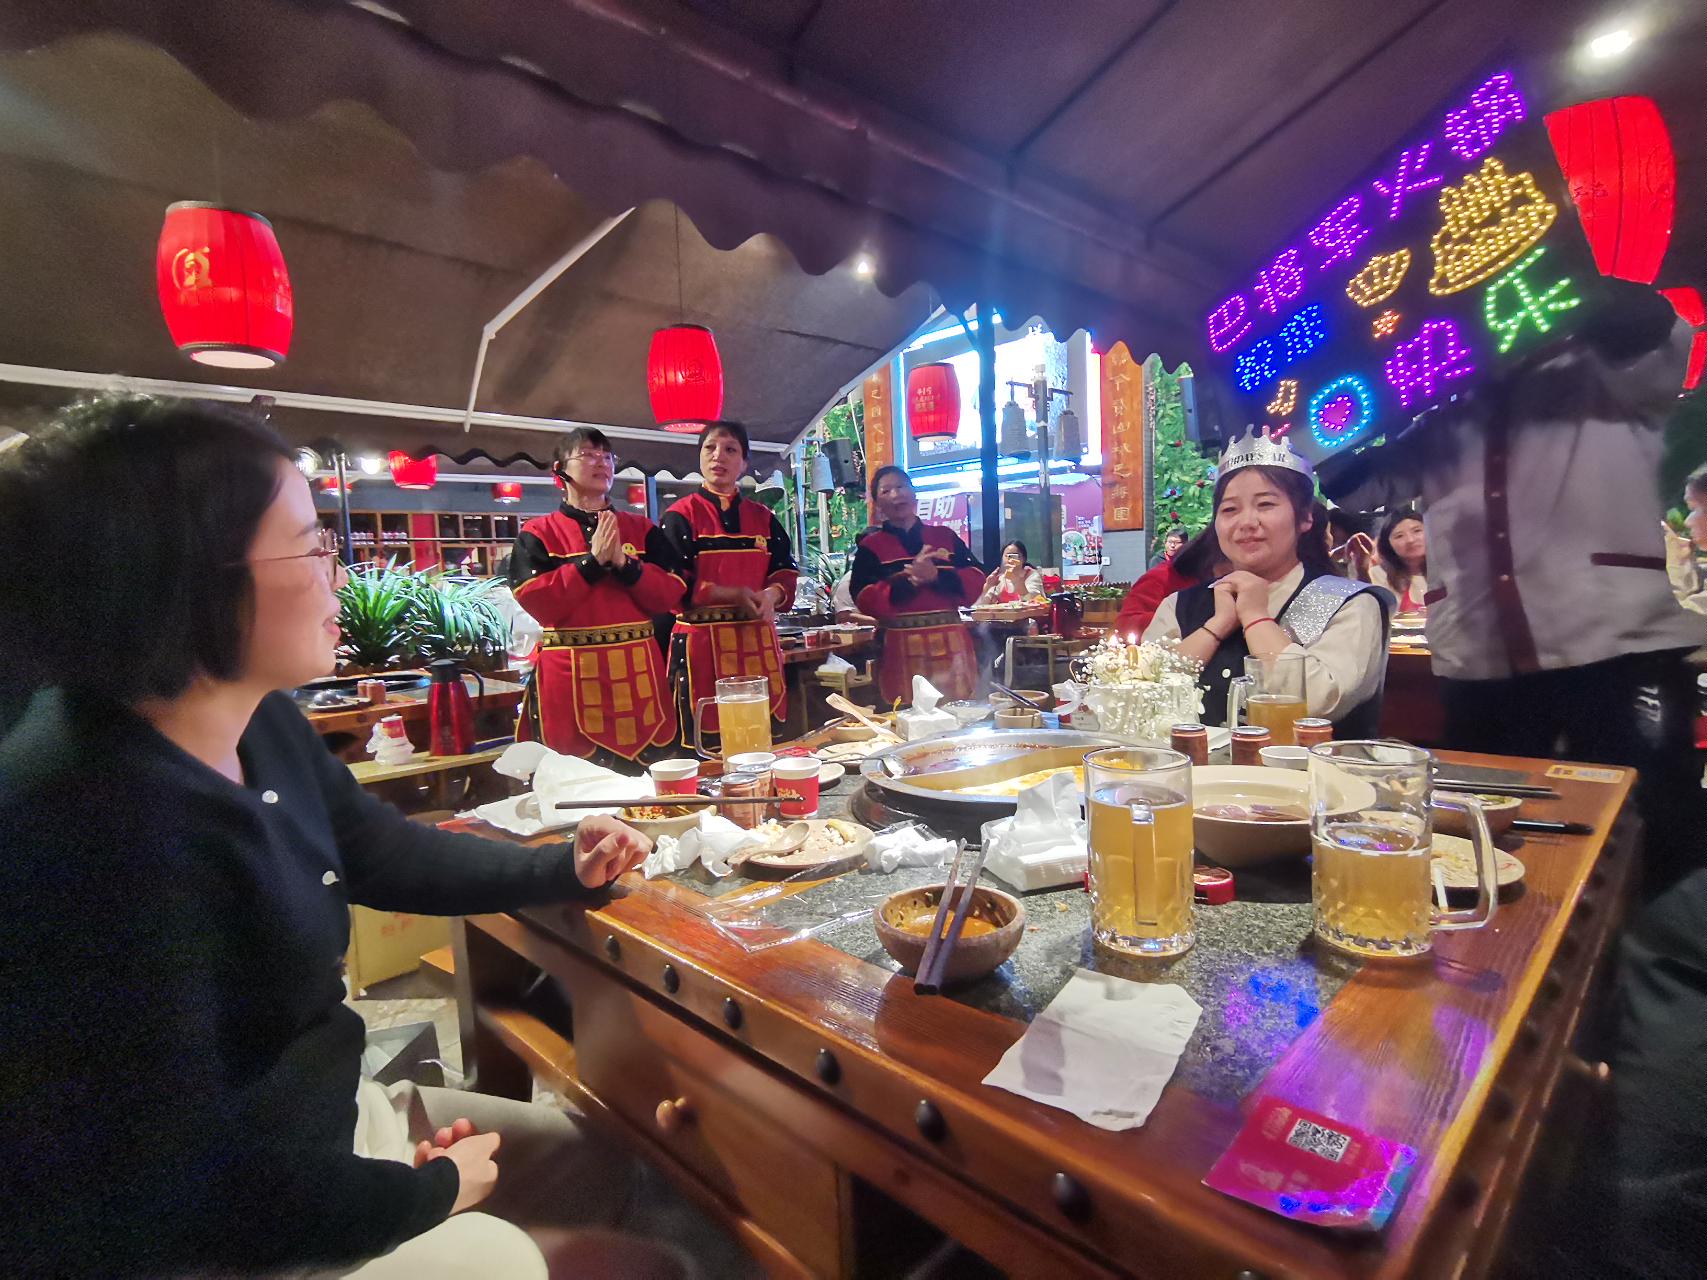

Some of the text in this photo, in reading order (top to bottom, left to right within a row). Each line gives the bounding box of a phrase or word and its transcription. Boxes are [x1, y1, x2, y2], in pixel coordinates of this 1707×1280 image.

[1208, 72, 1524, 351] 巴将军火锅
